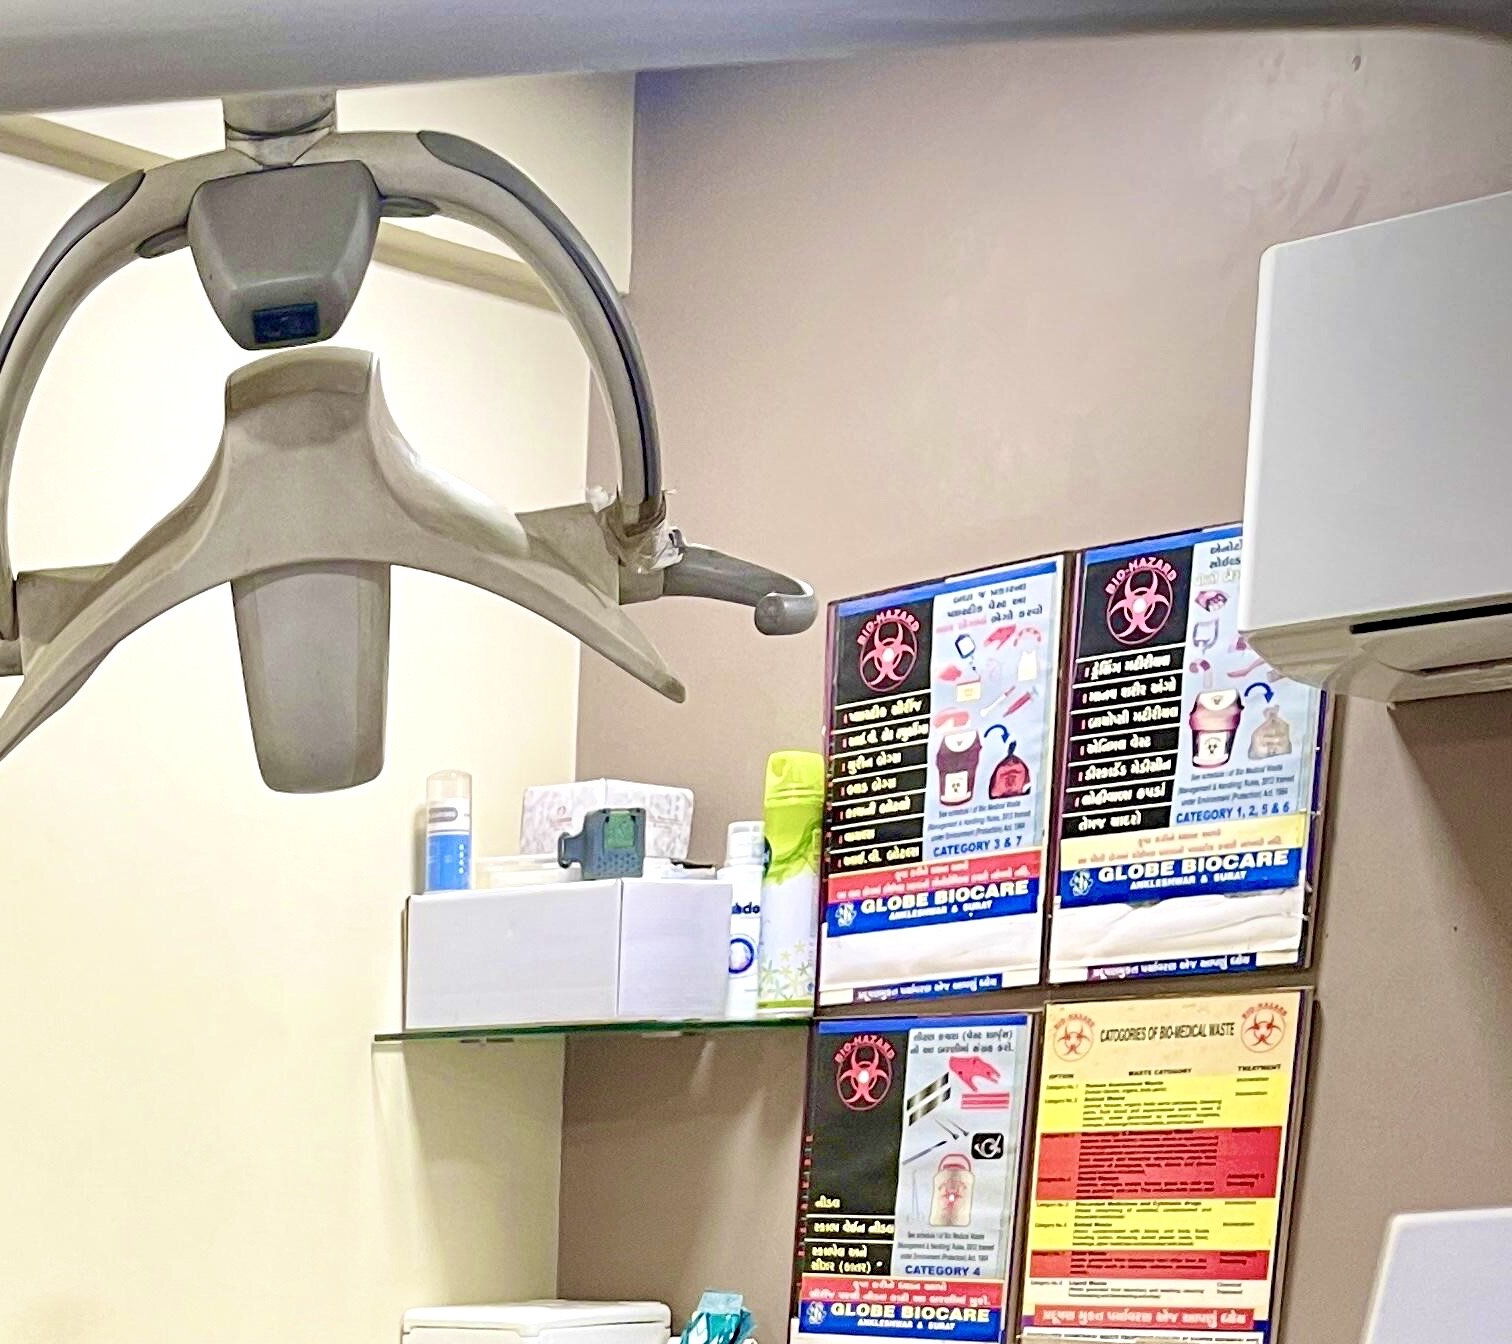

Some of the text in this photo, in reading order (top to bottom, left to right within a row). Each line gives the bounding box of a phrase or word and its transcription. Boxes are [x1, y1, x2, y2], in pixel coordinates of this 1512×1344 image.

[1105, 557, 1177, 595] BIO-HAZARD
[856, 607, 920, 647] BIO-HAZARD
[1176, 807, 1233, 824] CATEGORY
[1237, 806, 1246, 819] 1,
[1261, 803, 1268, 815] 5
[1271, 801, 1279, 814] &
[1282, 800, 1290, 813] 6
[933, 835, 1023, 857] CATEGORY 3 & 7
[1098, 859, 1175, 884] GLOBE
[1181, 849, 1289, 874] BIOCARE
[860, 891, 928, 914] GLOBE
[934, 880, 1029, 906] BIOCARE
[1100, 1021, 1236, 1043] CATOGORIES OF BIO-MEDICAL WASTE
[834, 1034, 896, 1063] BIO-HAZARD
[905, 1264, 981, 1277] CATEGORY 4
[830, 1302, 990, 1322] GLOBE BIOCARE
